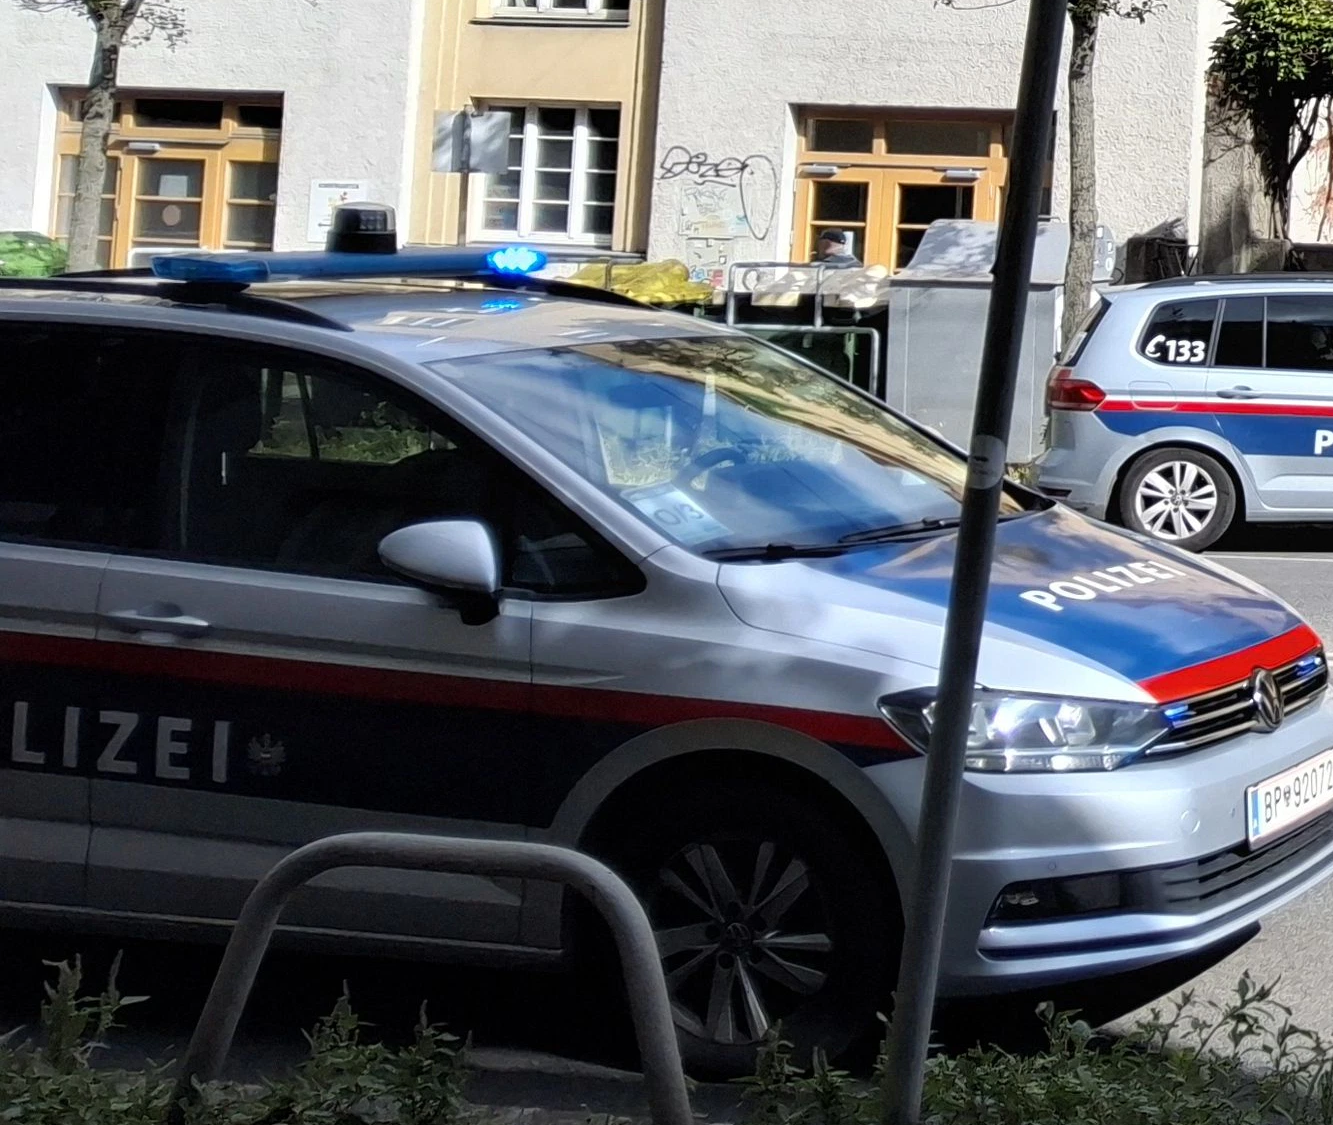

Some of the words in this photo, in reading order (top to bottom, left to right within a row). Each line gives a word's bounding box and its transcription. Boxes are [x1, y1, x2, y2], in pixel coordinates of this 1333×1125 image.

[1165, 339, 1206, 363] 133
[1018, 560, 1187, 612] POLIZEI
[11, 701, 230, 784] LIZEI
